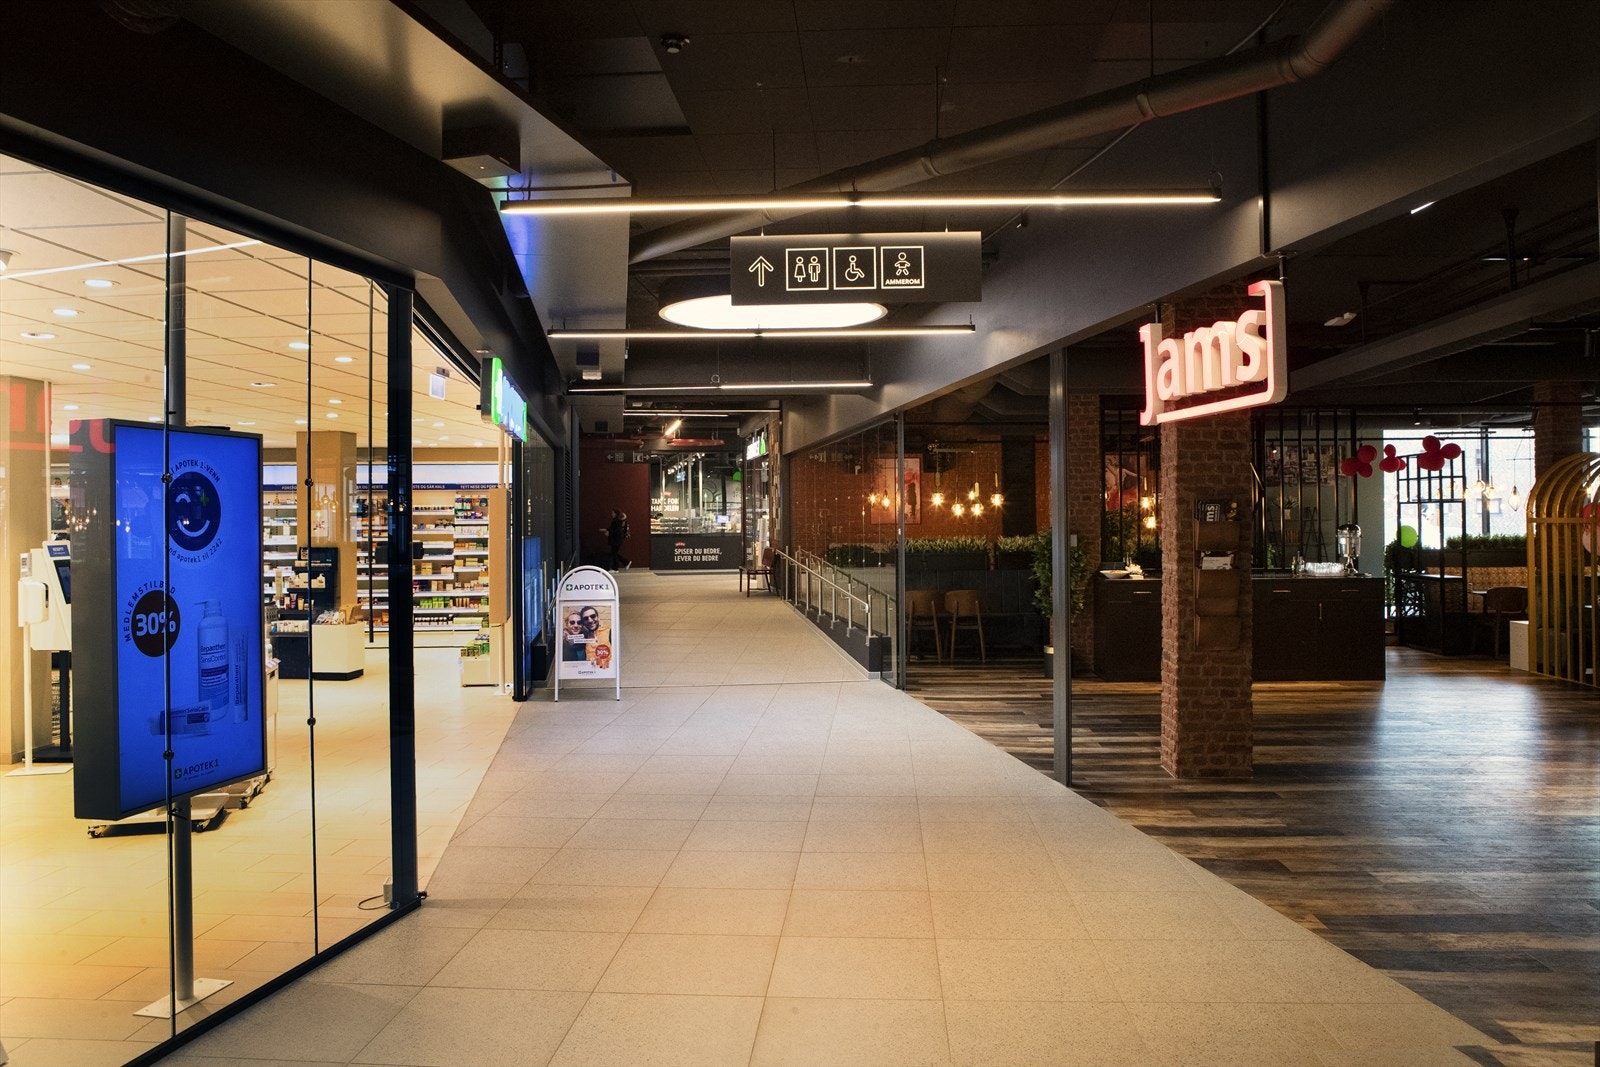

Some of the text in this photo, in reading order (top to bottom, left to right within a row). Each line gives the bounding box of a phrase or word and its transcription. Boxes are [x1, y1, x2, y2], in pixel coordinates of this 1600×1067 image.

[174, 459, 199, 472] APOTEK
[703, 548, 722, 556] BEDRE,
[573, 583, 604, 591] APOTEK
[123, 580, 176, 642] MEDLEMSTILBD
[135, 611, 177, 637] 30%
[182, 759, 214, 776] APOTEK
